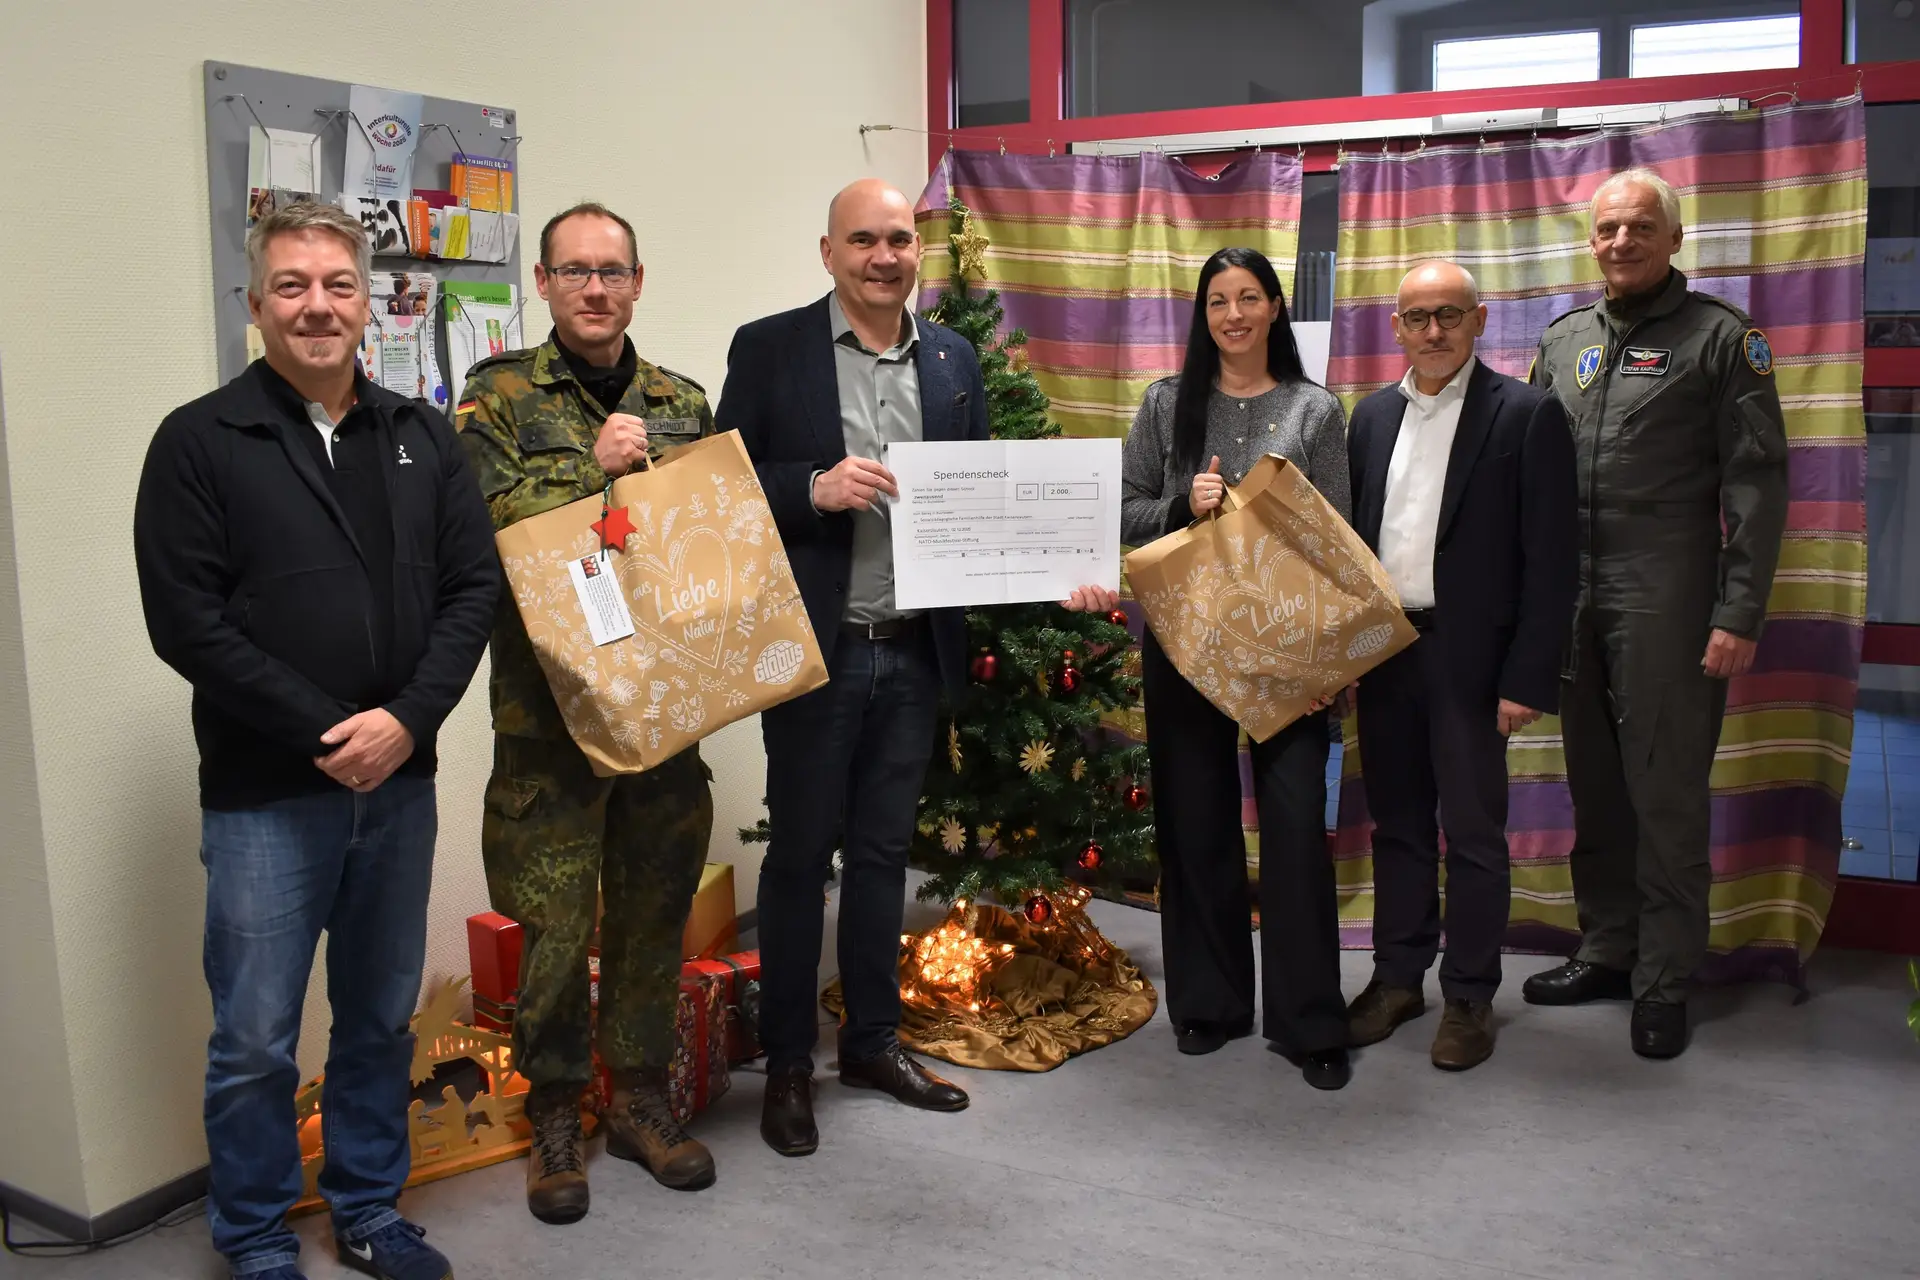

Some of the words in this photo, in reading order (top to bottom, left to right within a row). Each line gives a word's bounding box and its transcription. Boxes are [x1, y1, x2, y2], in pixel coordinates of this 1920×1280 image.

[367, 114, 412, 136] Interkulturelle
[372, 132, 392, 147] Woche
[392, 138, 407, 147] 2025
[933, 470, 1010, 481] Spendenscheck
[633, 581, 653, 600] aus
[655, 572, 720, 624] Liebe
[693, 604, 706, 619] zur
[1231, 604, 1249, 620] aus
[1250, 590, 1307, 637] Liebe
[683, 618, 715, 646] Natur
[1284, 618, 1296, 630] zur
[1277, 627, 1306, 650] Natur
